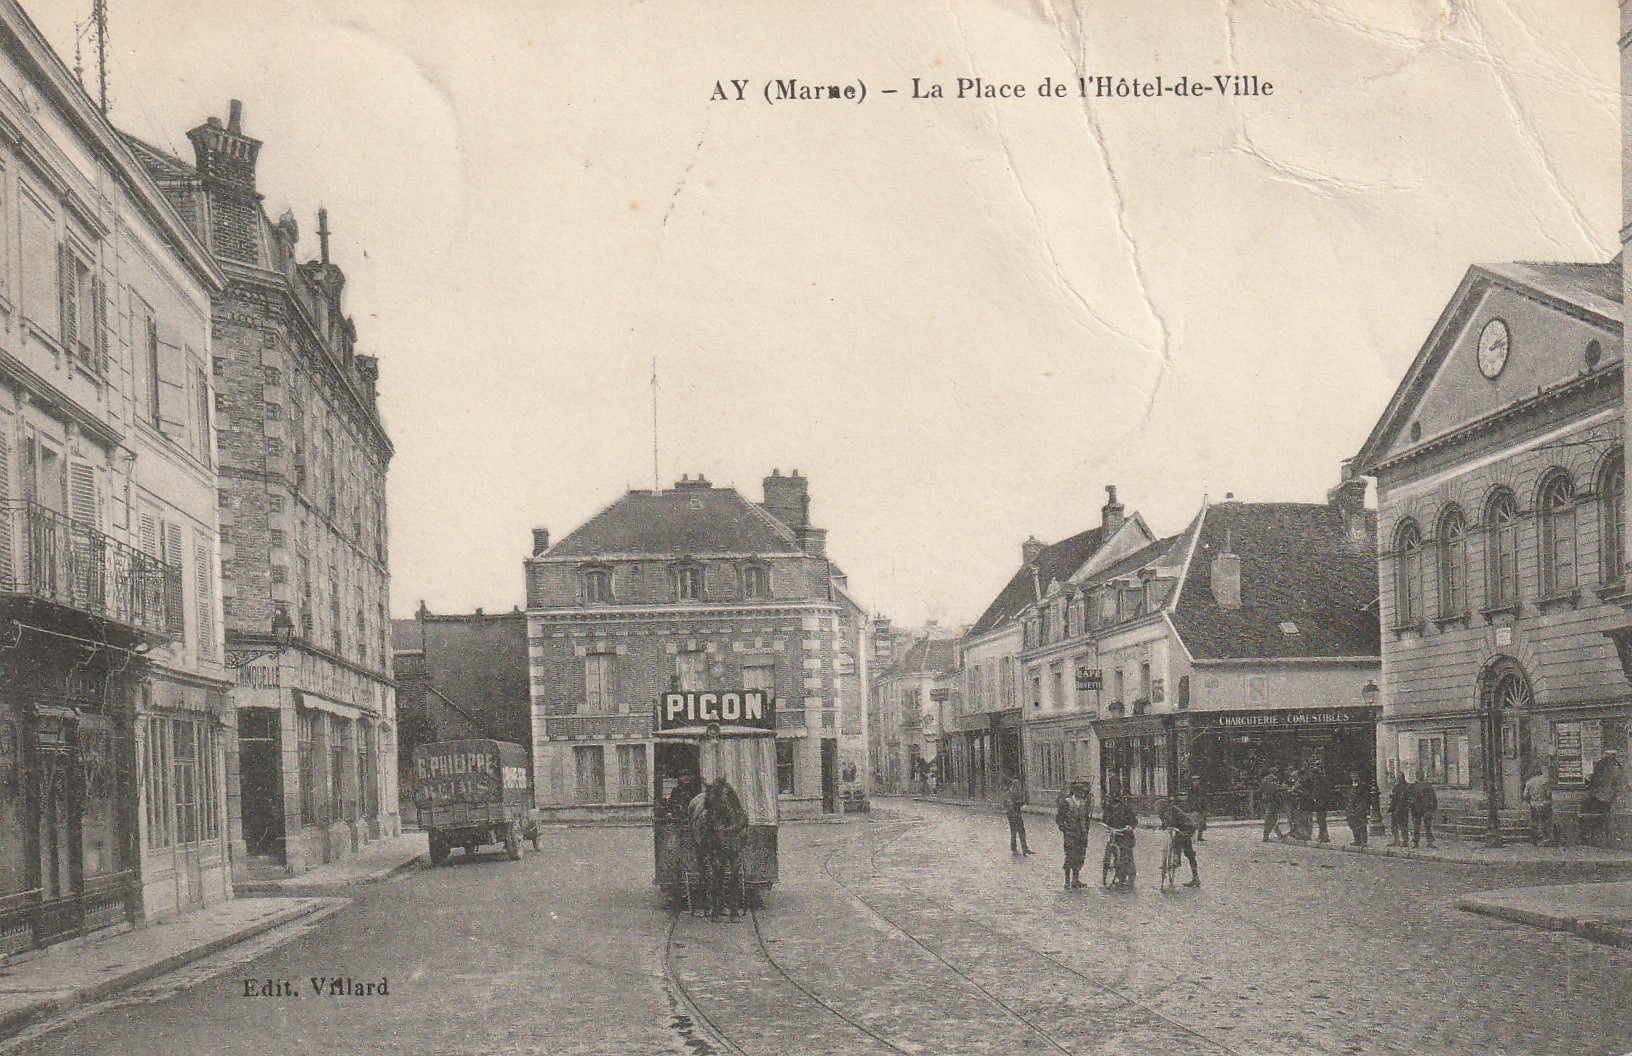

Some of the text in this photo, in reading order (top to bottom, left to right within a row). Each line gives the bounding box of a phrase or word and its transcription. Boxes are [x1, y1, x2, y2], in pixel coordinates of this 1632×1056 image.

[666, 692, 762, 721] PICON
[1218, 712, 1350, 727] CHARCUTERIE COMESTIBLES
